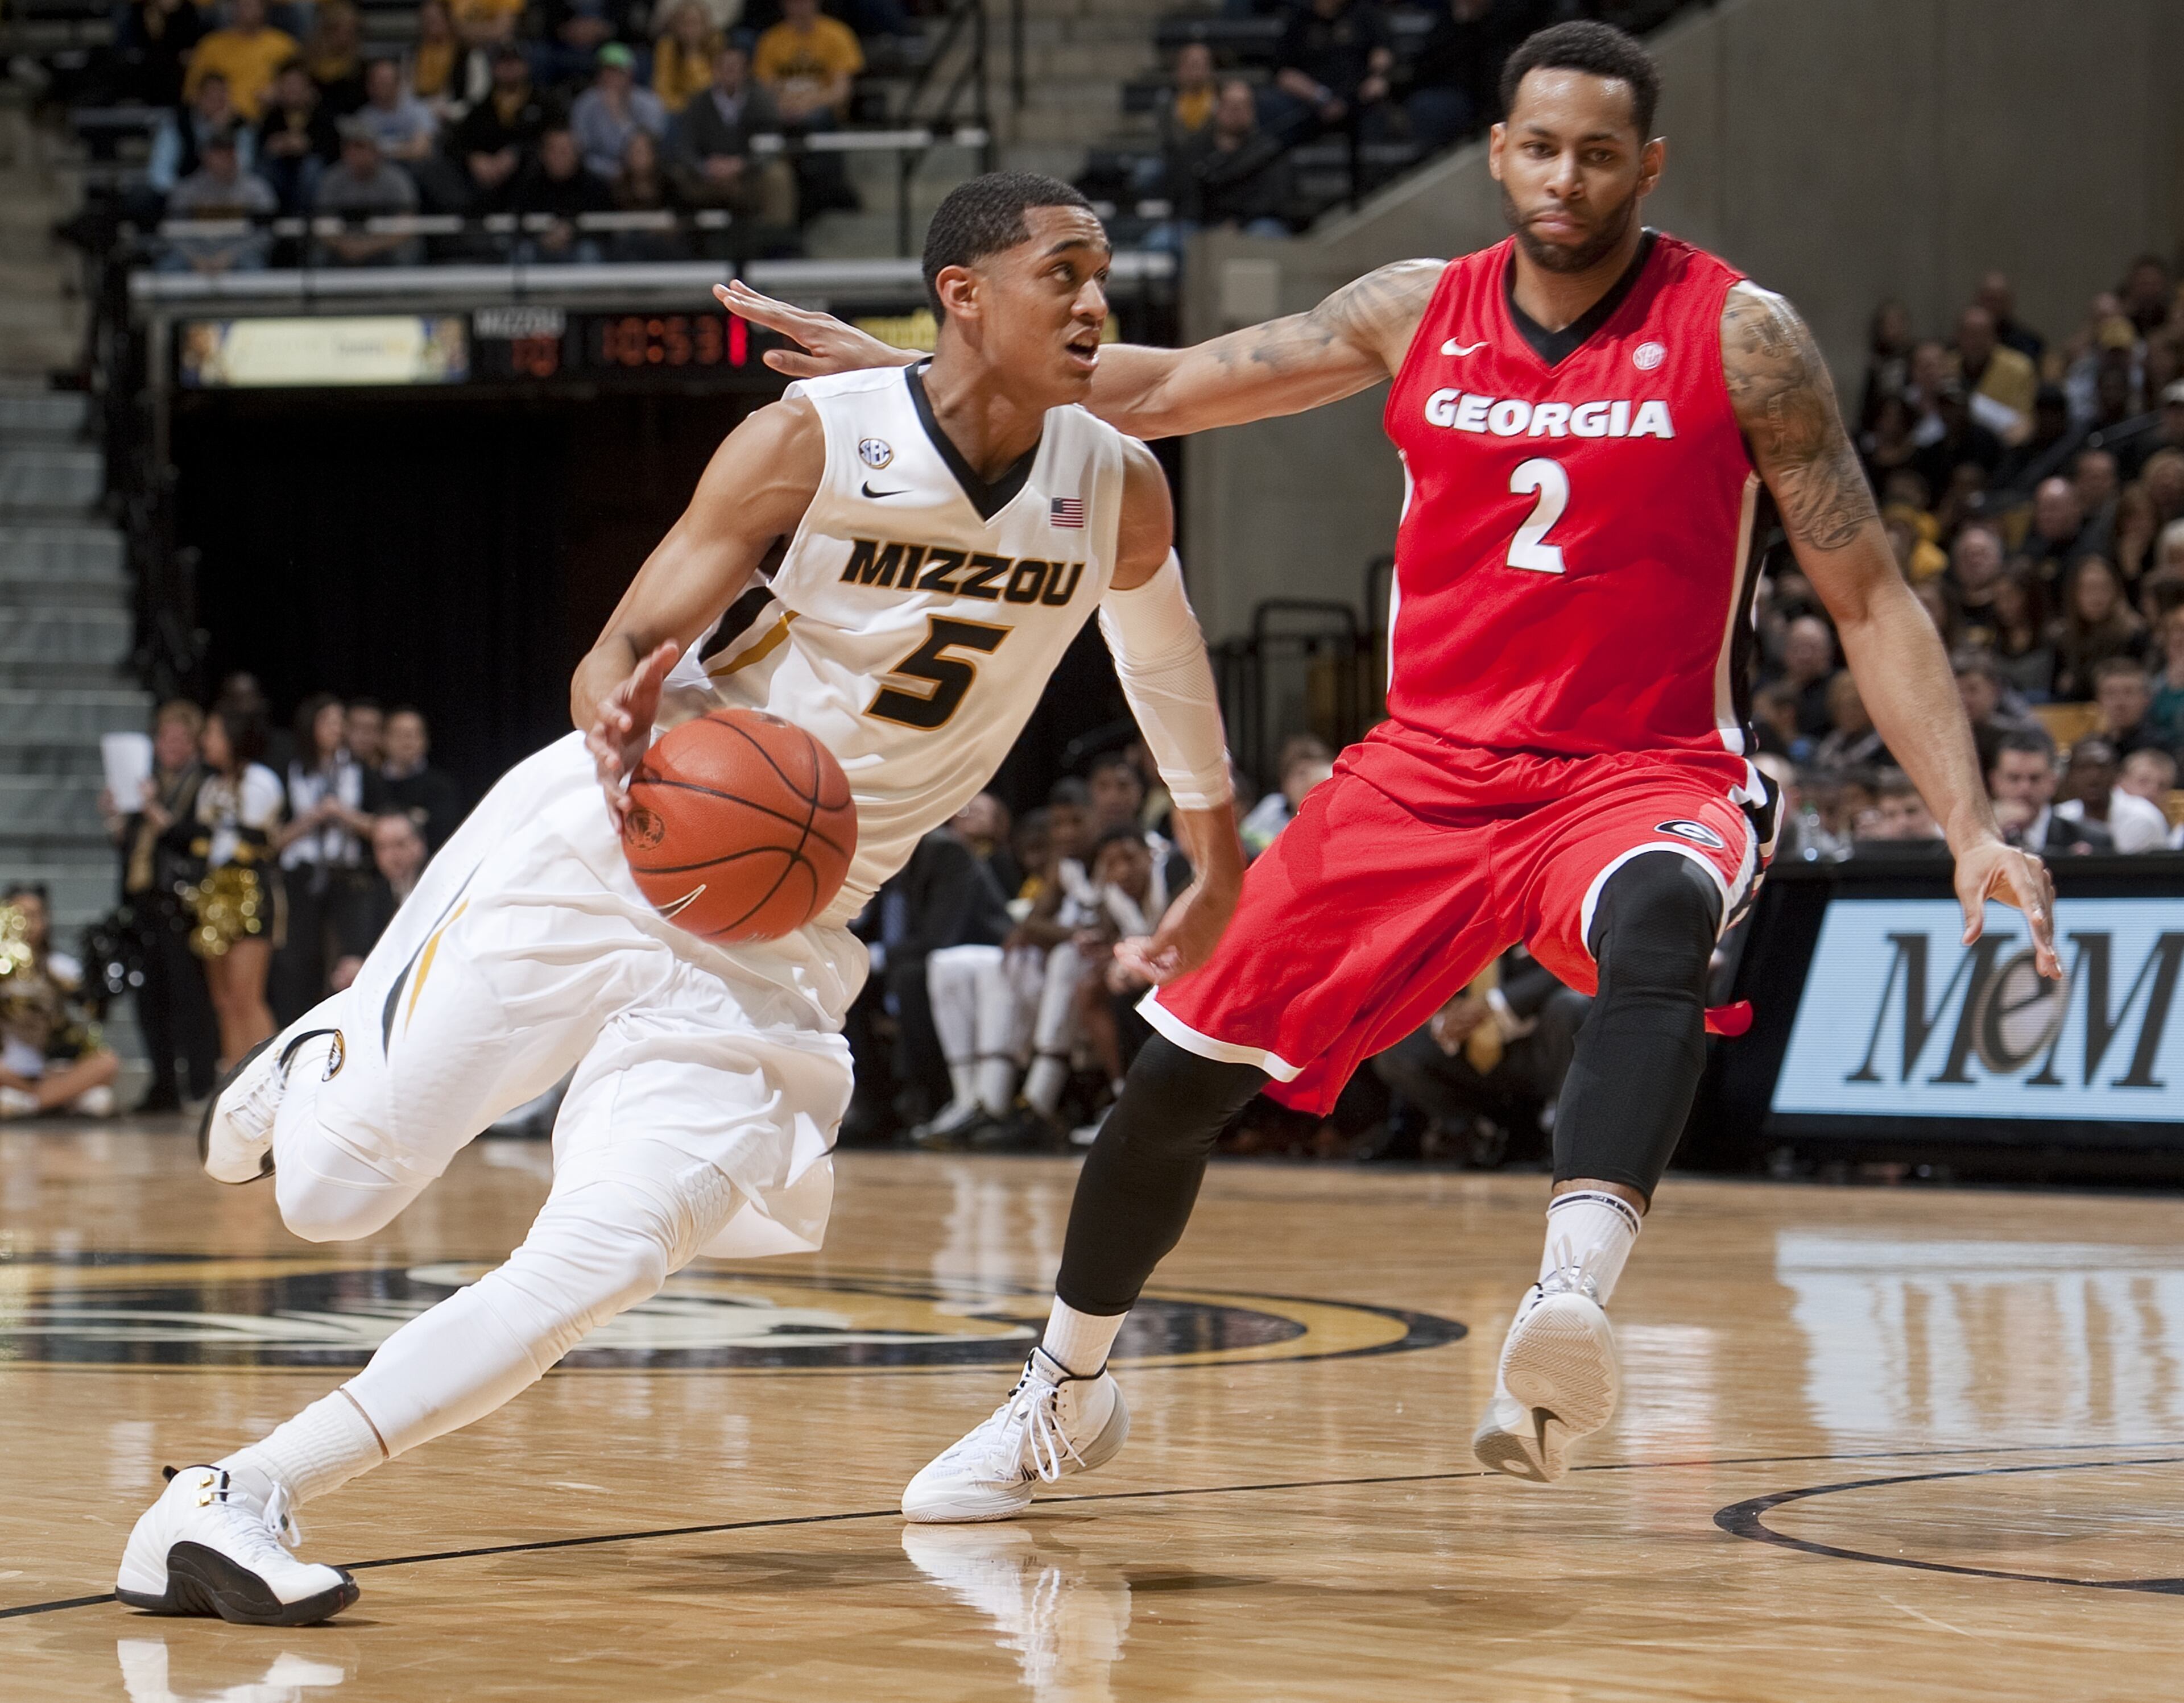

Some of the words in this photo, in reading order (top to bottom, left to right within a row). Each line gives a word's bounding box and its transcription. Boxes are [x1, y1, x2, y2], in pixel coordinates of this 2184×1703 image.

[1424, 388, 1676, 440] GEORGIA
[859, 439, 892, 467] SEC
[1505, 457, 1570, 574] 2
[838, 536, 1086, 607] MIZZOU
[862, 614, 1015, 732] 5
